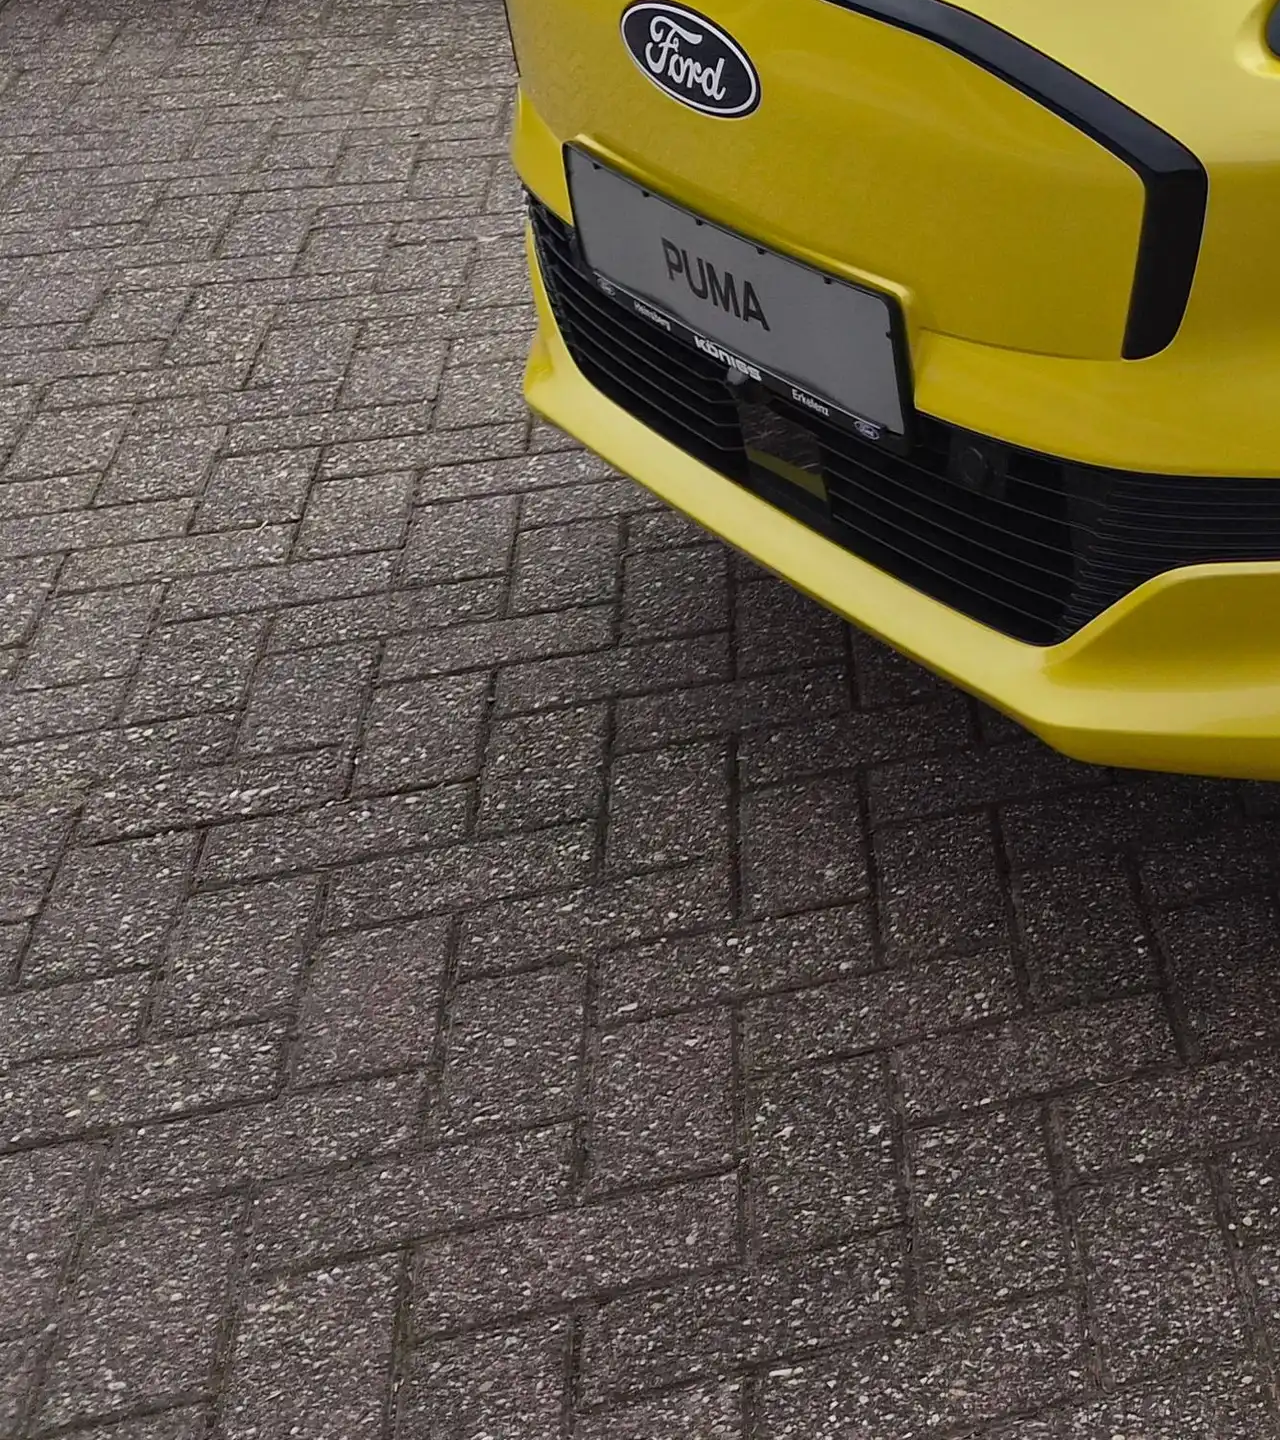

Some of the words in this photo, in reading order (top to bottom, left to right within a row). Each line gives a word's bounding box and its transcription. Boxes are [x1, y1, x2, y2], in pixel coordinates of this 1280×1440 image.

[645, 15, 727, 101] Ford
[661, 237, 770, 332] PUMA
[693, 335, 762, 382] KÖNIGS
[791, 388, 830, 417] Erkelenz
